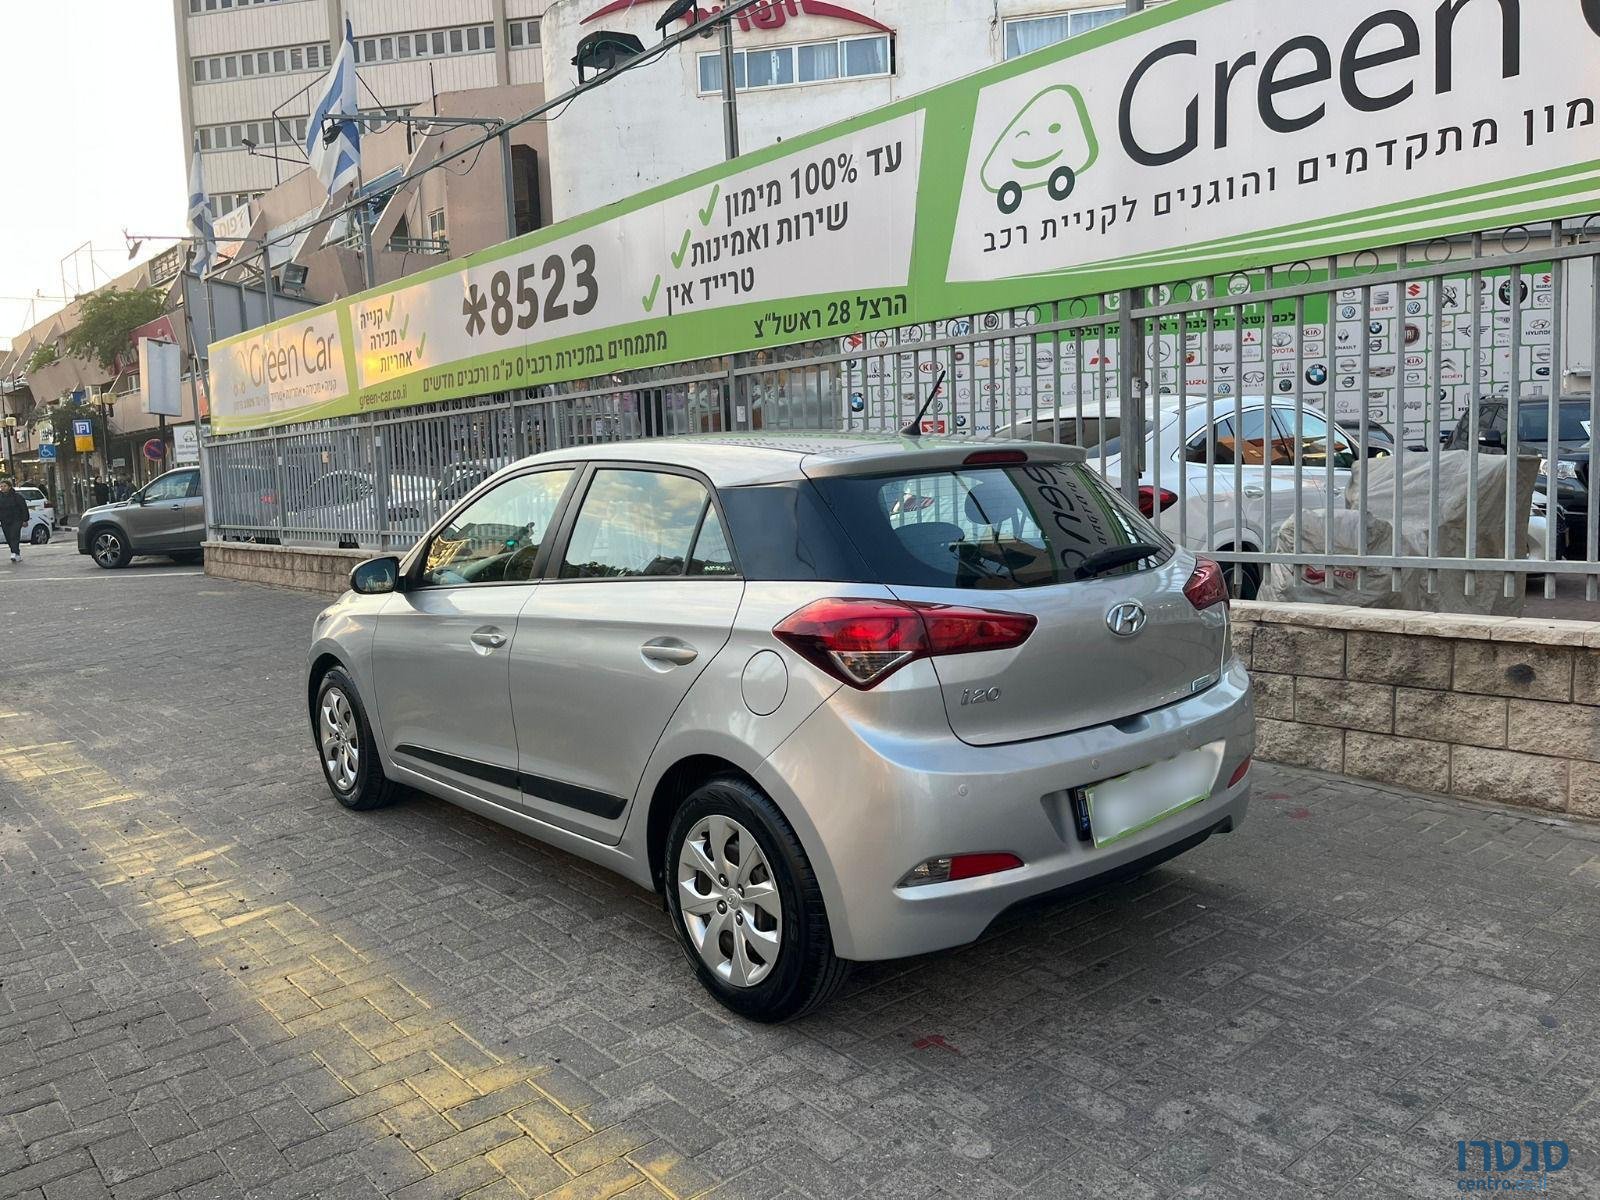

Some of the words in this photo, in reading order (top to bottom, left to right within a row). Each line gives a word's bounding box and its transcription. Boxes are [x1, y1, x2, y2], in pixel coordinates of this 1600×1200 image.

[1117, 0, 1520, 167] Green
[866, 141, 902, 177] עד
[1298, 118, 1498, 185] מתקדמים
[790, 153, 858, 199] 100%
[725, 179, 782, 227] מימון
[1154, 166, 1277, 217] והוגנים
[776, 201, 849, 245] שירות
[1040, 195, 1138, 241] לקניית
[691, 223, 769, 267] ואמינות
[983, 225, 1028, 253] רכב
[700, 266, 755, 301] טרייד
[666, 280, 694, 317] אין
[856, 293, 908, 321] הרצל
[360, 308, 383, 329] קנייה
[827, 300, 850, 327] 28
[1171, 319, 1208, 330] לבחר
[370, 329, 397, 350] מכירה
[608, 330, 667, 360] מתמחים
[250, 344, 298, 387] Green
[302, 326, 334, 374] Car
[380, 350, 412, 373] אחריות
[527, 355, 552, 374] רכבי
[555, 343, 604, 370] במכירת
[423, 373, 454, 393] חדשים
[457, 366, 489, 387] ורכבים
[360, 384, 408, 409] green-car.co.il
[961, 687, 1000, 705] i20
